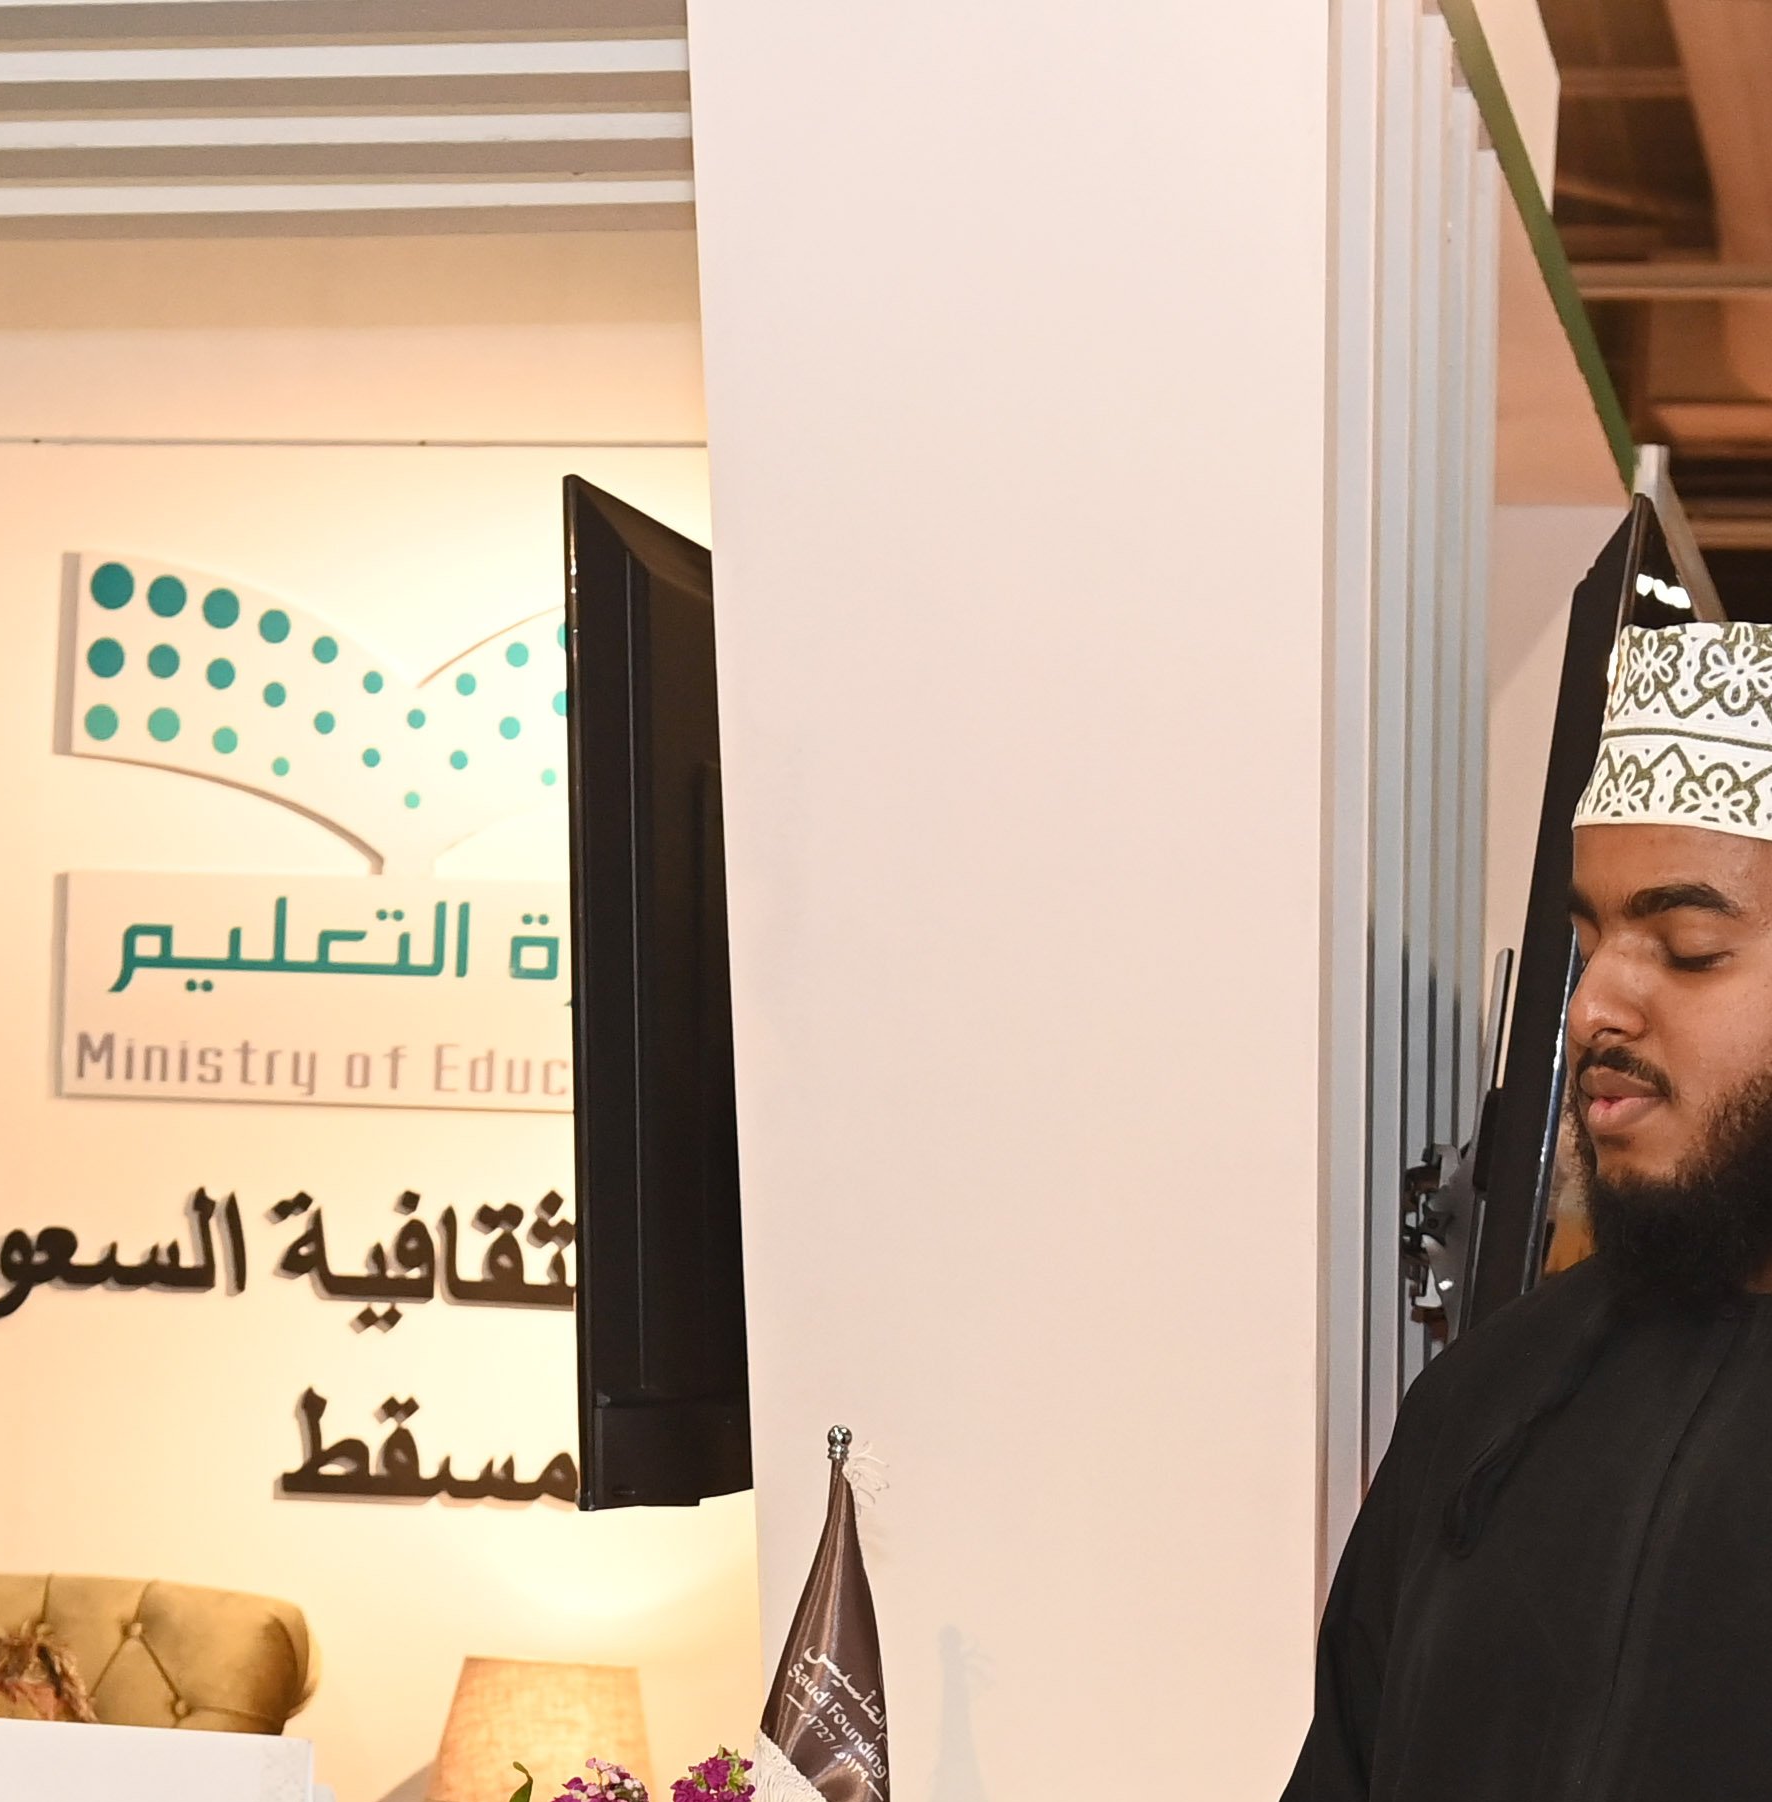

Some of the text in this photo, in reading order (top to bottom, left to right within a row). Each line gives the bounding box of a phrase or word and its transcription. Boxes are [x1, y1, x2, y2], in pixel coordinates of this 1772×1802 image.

[108, 896, 470, 992] التعليم
[76, 1031, 568, 1096] Ministry of Educ
[270, 1190, 576, 1330] ثقافية
[788, 1662, 888, 1779] Saudi Founding
